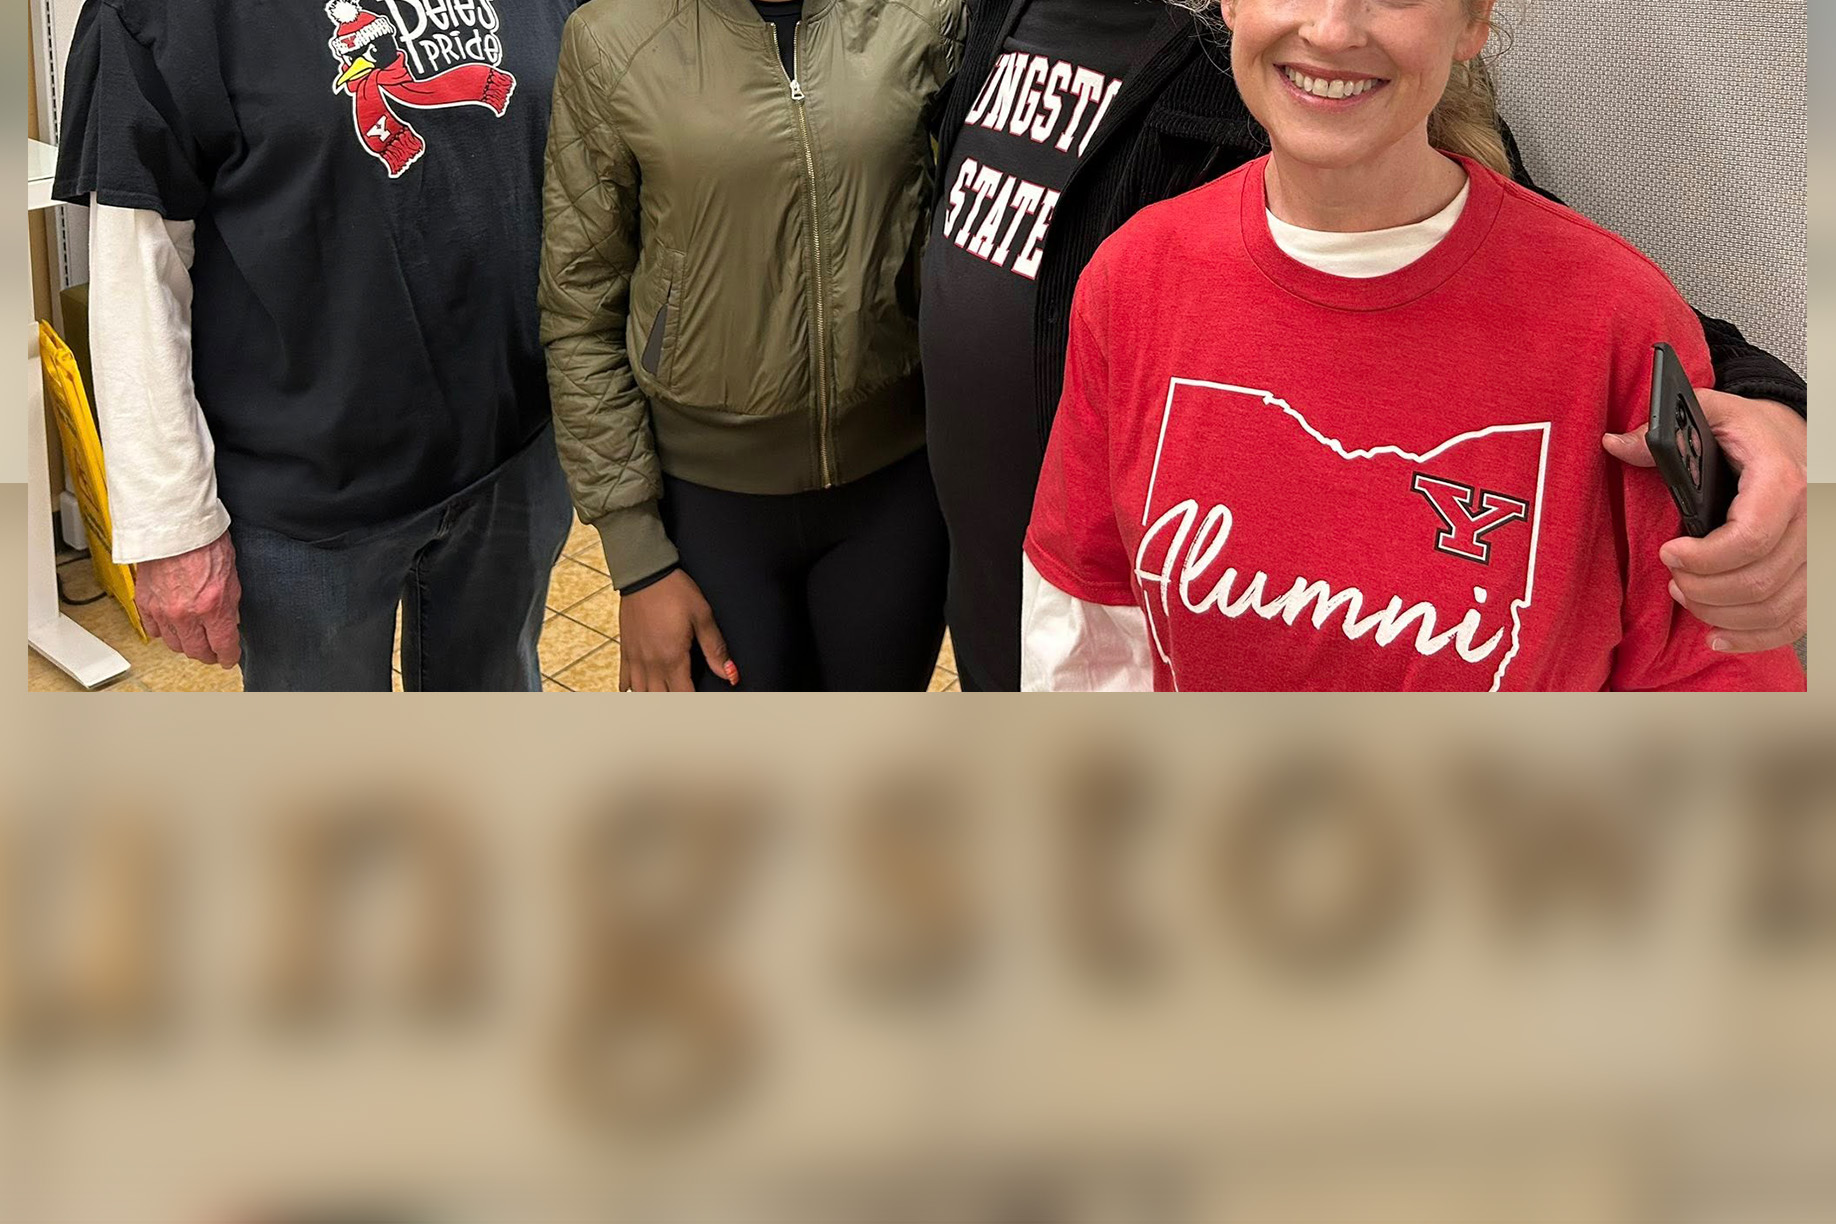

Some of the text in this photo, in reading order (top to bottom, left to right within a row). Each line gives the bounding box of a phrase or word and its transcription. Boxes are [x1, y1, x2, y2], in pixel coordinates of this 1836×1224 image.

[366, 115, 391, 142] Y
[943, 157, 1061, 280] STATE
[1410, 471, 1530, 565] Y
[1134, 498, 1505, 664] Alumni
